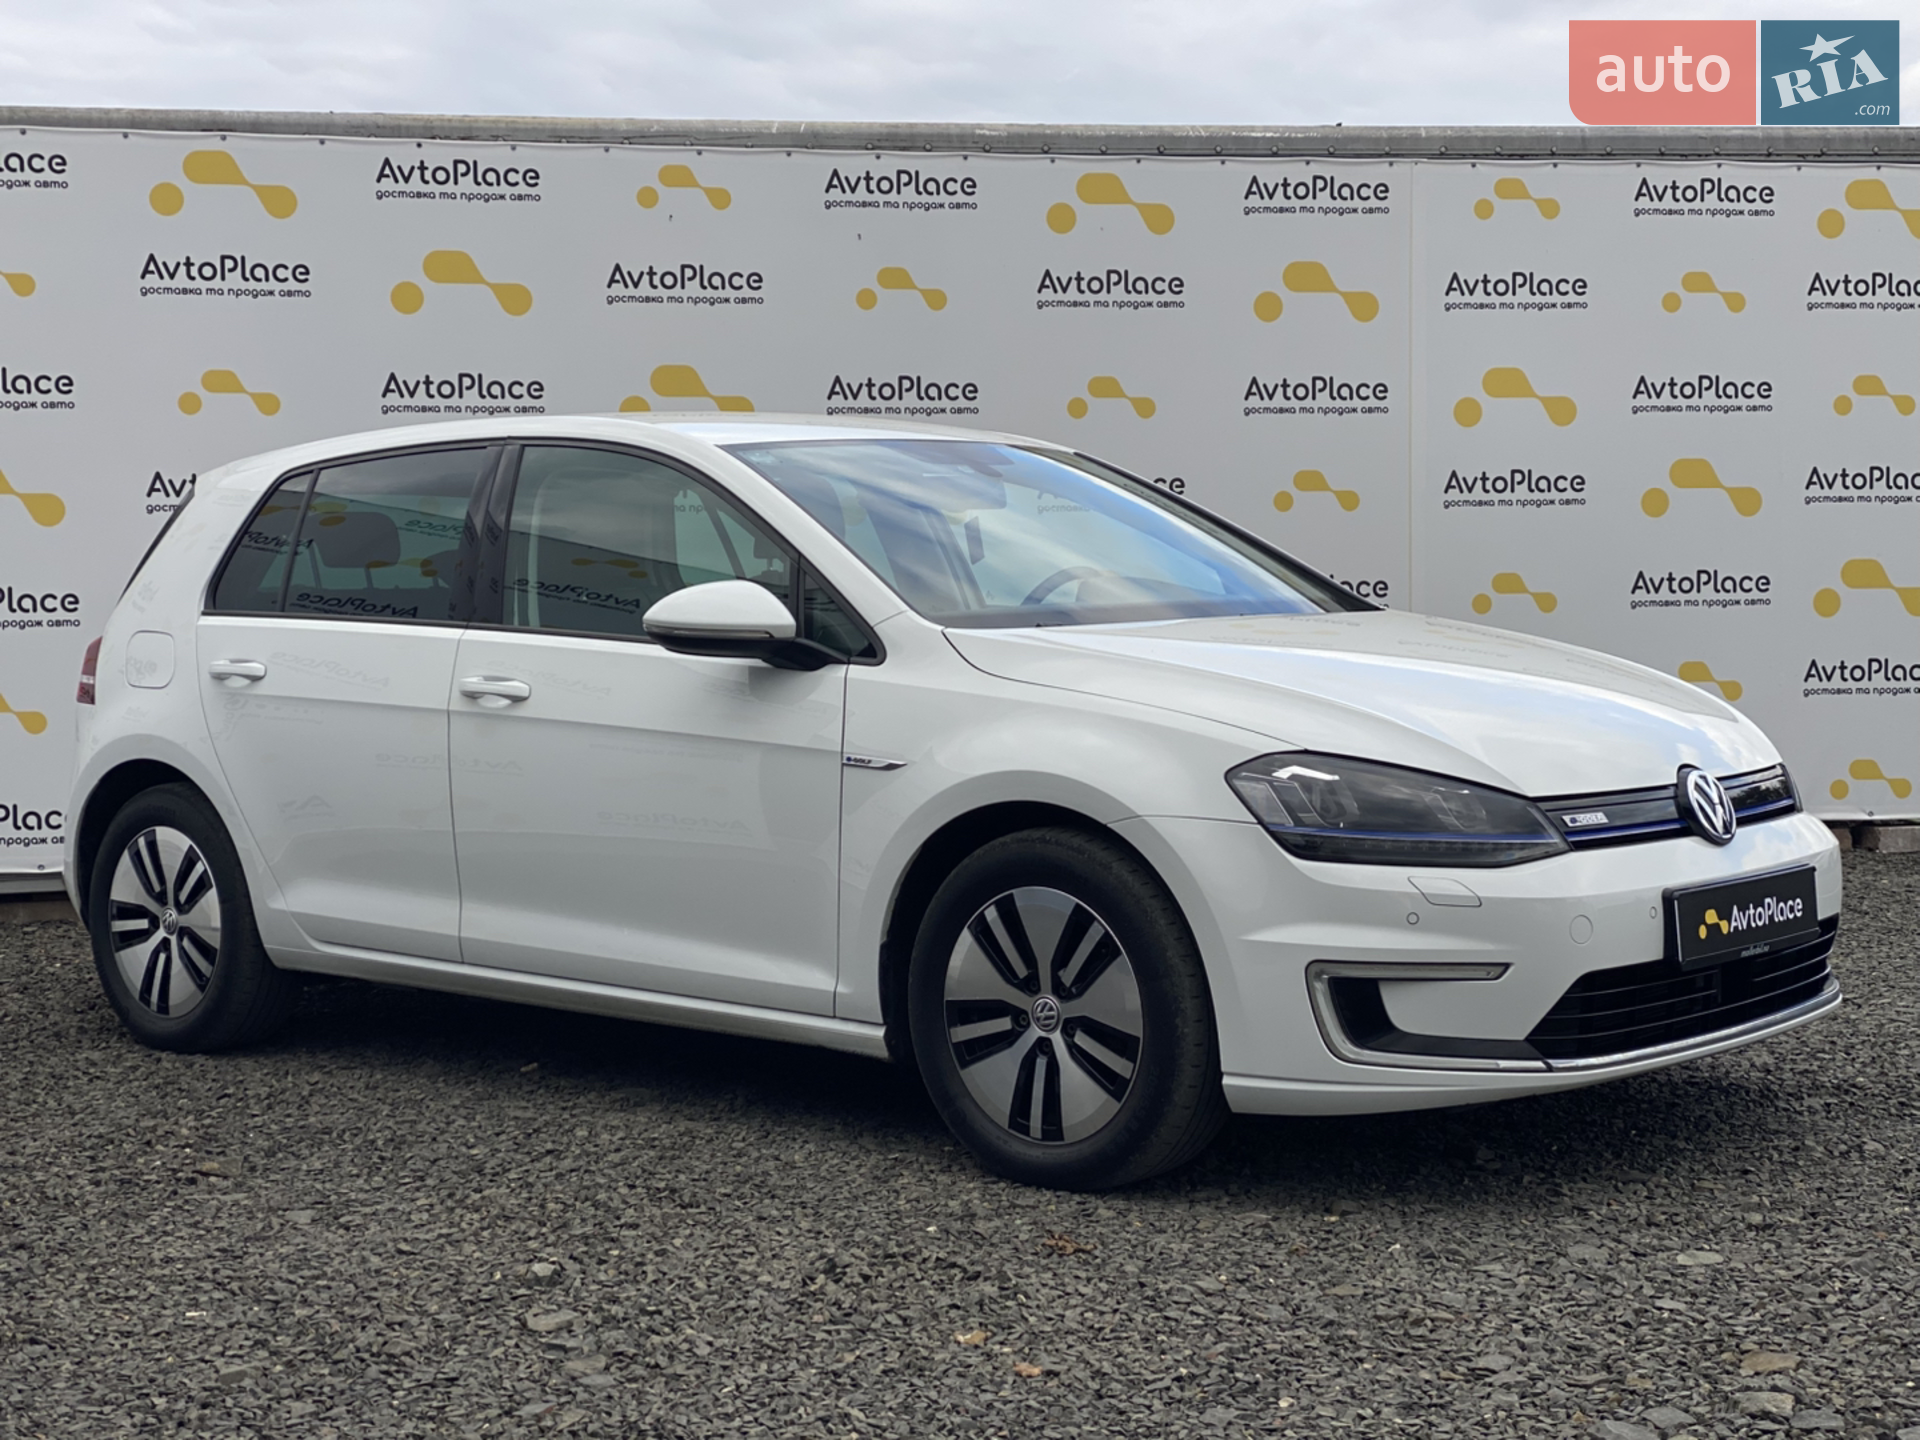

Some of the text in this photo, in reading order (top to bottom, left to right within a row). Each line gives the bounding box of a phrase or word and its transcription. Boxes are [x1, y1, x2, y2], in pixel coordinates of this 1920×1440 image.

[376, 157, 541, 188] AvtoPlace
[33, 180, 69, 189] авто
[825, 168, 978, 197] AvtoPlace
[1244, 175, 1390, 202] AvtoPlace
[375, 190, 542, 203] доставка та продаж авто
[1634, 177, 1776, 204] AvtoPlace
[823, 200, 979, 212] доставка та продаж авто
[1242, 206, 1298, 216] доставка
[1298, 206, 1316, 214] та
[1316, 206, 1360, 216] продаж
[1632, 208, 1776, 218] доставка та продаж авто
[140, 253, 311, 284] AvtoPlace
[607, 263, 764, 291] AvtoPlace
[1037, 269, 1185, 296] AvtoPlace
[1445, 272, 1588, 298] AvtoPlace
[139, 286, 312, 299] доставка та продаж авто
[605, 295, 765, 306] доставка та продаж авто
[1035, 300, 1092, 310] доставка
[1092, 300, 1111, 308] та
[1111, 300, 1155, 310] продаж
[1443, 302, 1589, 312] доставка та продаж авто
[1806, 302, 1858, 312] доставка
[1858, 302, 1876, 310] та
[1876, 302, 1916, 312] продаж
[381, 372, 545, 401] AvtoPlace
[827, 375, 979, 402] AvtoPlace
[1244, 376, 1389, 402] AvtoPlace
[1632, 375, 1773, 401] AvtoPlace
[40, 401, 76, 409] авто
[380, 405, 546, 417] доставка та продаж авто
[1630, 405, 1774, 415] доставка та продаж авто
[825, 406, 980, 417] доставка та продаж авто
[1242, 406, 1390, 417] доставка та продаж авто
[1444, 469, 1587, 495] AvtoPlace
[1442, 498, 1587, 509] доставка та продаж авто
[1803, 495, 1856, 506] доставка
[1856, 495, 1873, 503] та
[1873, 495, 1914, 505] продаж
[1631, 569, 1772, 596] AvtoPlace
[1629, 598, 1772, 610] доставка та продаж авто
[46, 619, 82, 628] авто
[1802, 688, 1854, 698] доставка
[1872, 687, 1912, 697] продаж
[1730, 896, 1803, 933] AvtoPlace
